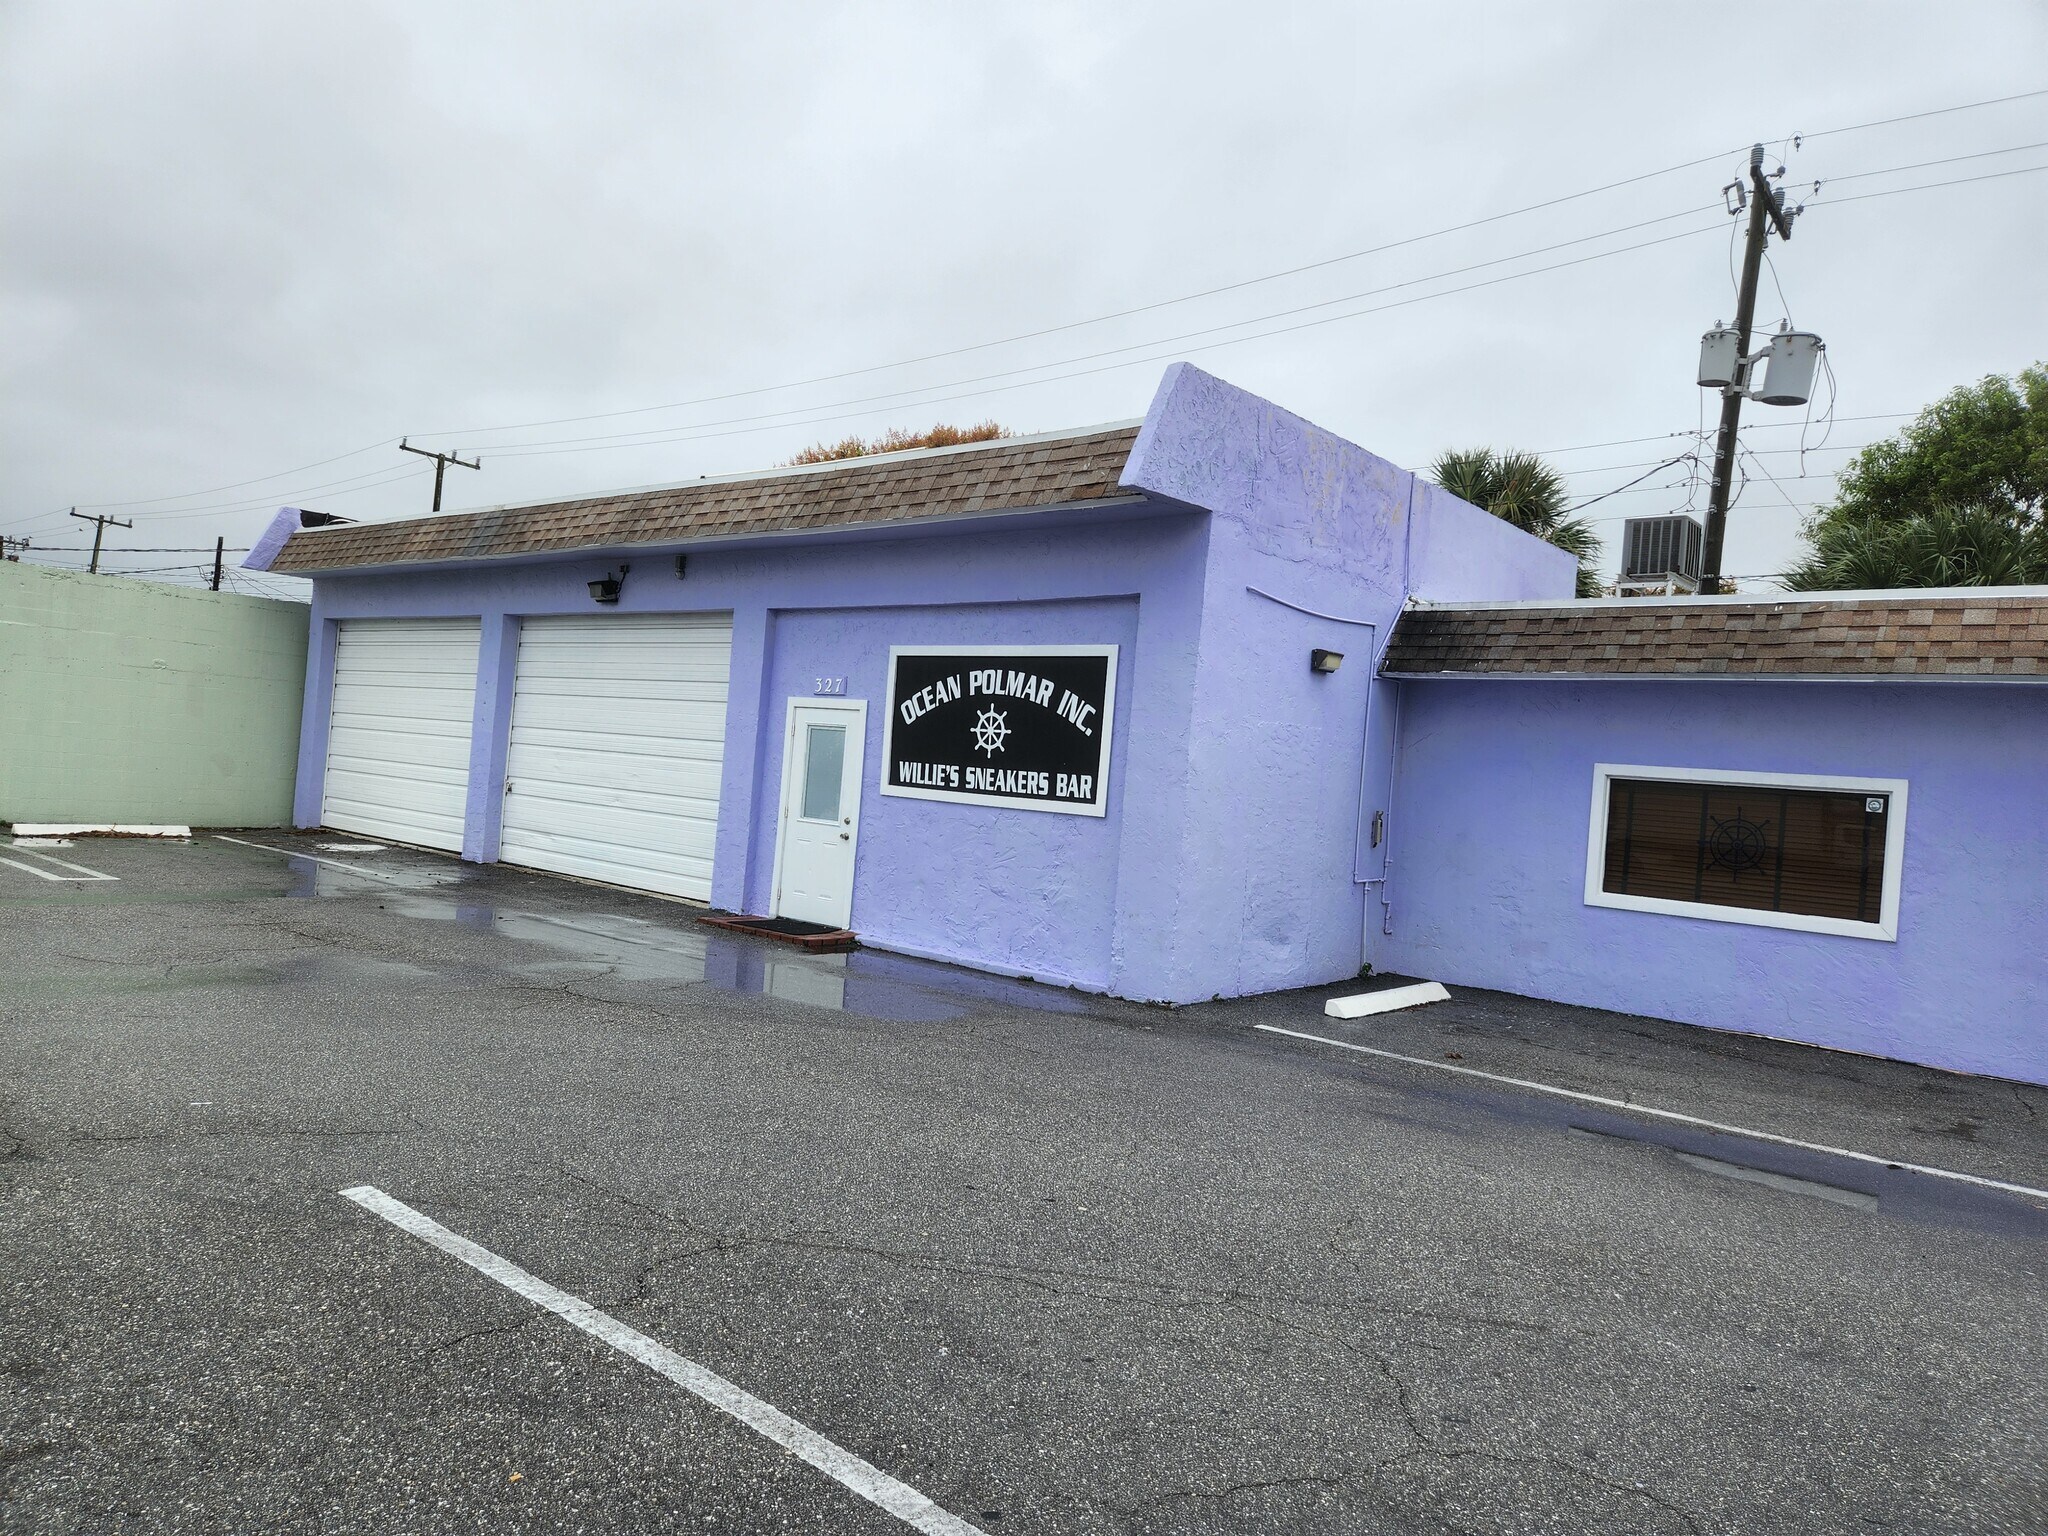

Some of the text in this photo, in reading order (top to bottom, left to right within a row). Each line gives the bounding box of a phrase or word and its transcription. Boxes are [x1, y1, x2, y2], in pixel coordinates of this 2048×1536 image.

[814, 678, 843, 693] 327
[900, 669, 1097, 737] OCEAN POLMAR INC.
[899, 761, 1093, 799] WILLIE'S SNEAKERS BAR
